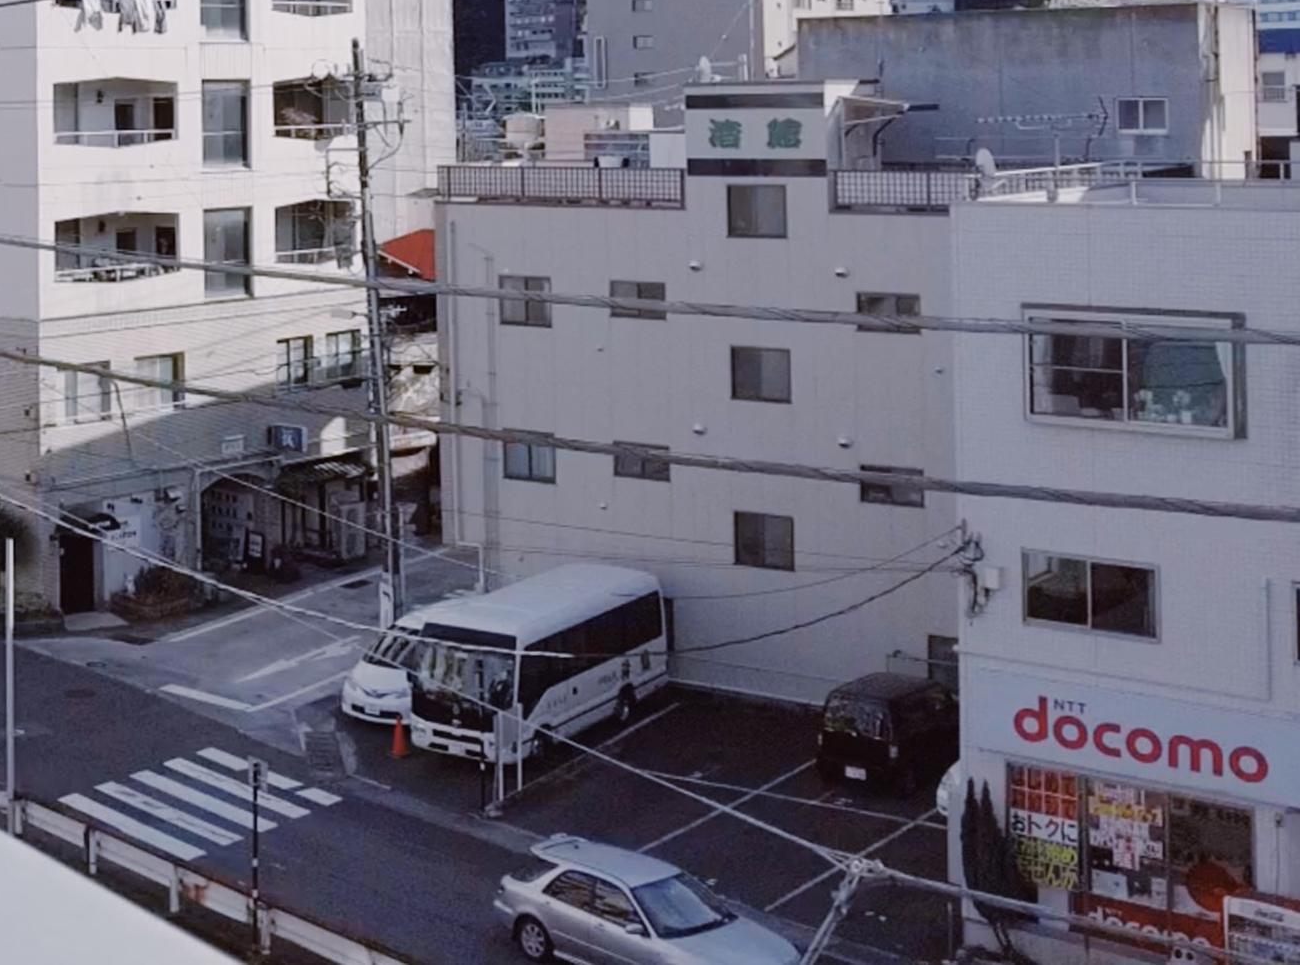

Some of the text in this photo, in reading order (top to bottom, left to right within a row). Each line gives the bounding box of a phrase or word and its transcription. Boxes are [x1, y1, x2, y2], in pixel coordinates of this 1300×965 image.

[1053, 698, 1087, 714] NTT
[1013, 695, 1269, 783] docomo
[1011, 814, 1078, 845] おトクに
